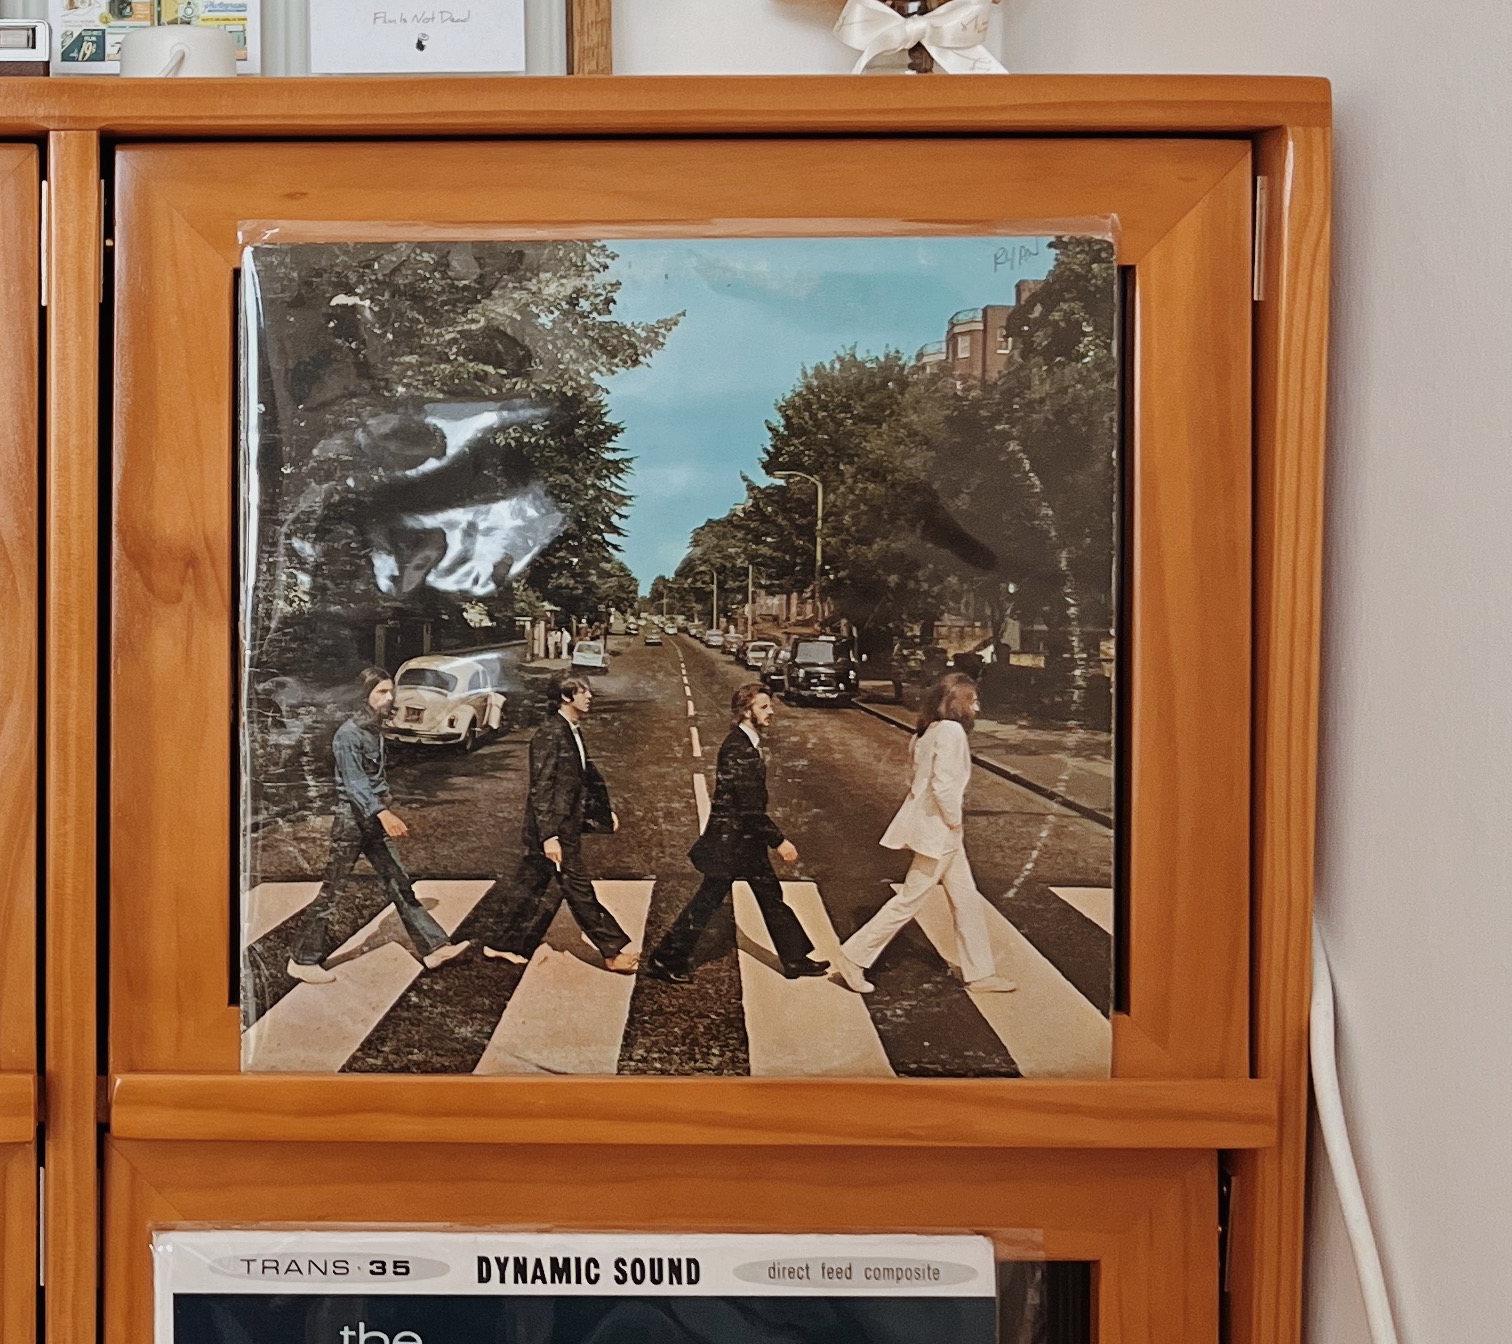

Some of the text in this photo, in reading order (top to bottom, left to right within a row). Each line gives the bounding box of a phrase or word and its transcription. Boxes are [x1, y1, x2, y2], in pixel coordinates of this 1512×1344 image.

[410, 11, 436, 25] Not
[240, 1260, 411, 1276] TRANS 35
[477, 1255, 701, 1286] DYNAMIC SOUND
[768, 1262, 940, 1284] direct feed composite
